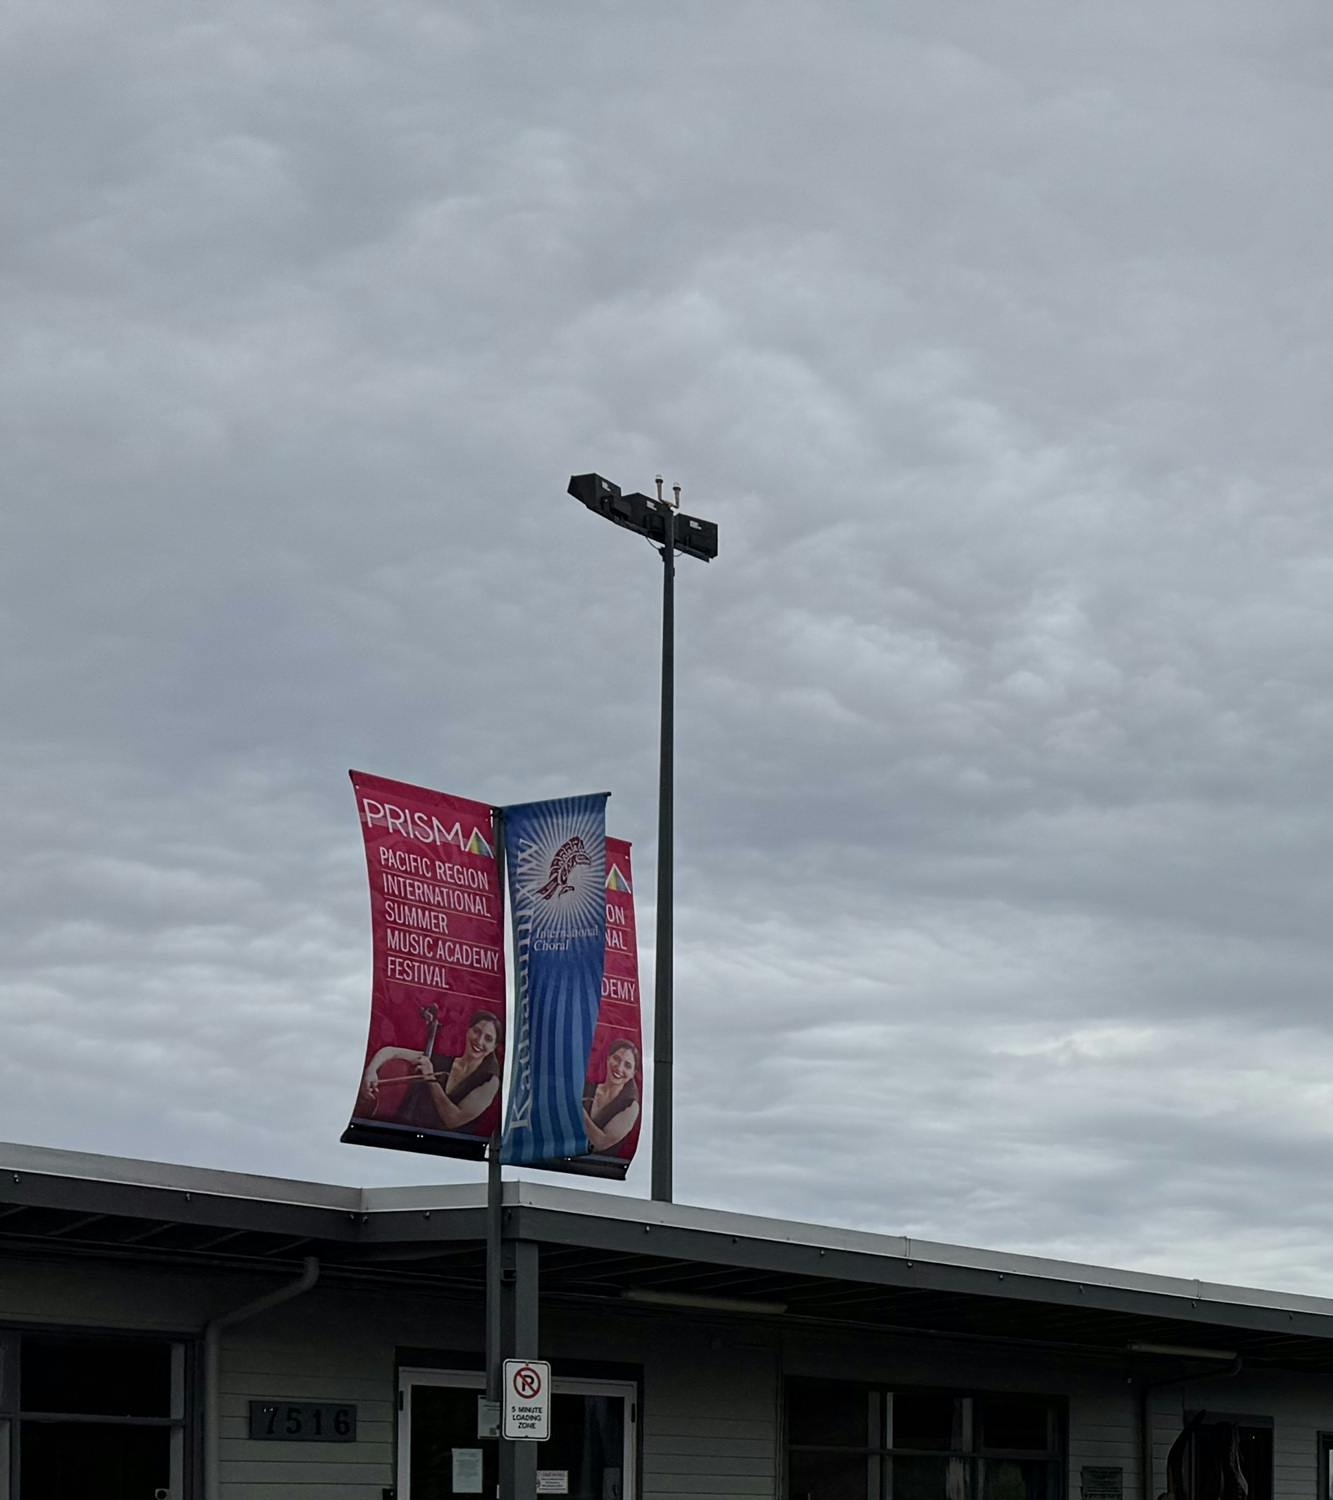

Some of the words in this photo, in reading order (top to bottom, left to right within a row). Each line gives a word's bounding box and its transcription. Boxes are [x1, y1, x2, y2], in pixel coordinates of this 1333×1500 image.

[379, 846, 432, 877] PACIFIC
[435, 861, 489, 890] REGION
[382, 873, 492, 917] INTERNATIONAL
[385, 902, 449, 934] SUMMER
[387, 928, 433, 957] MUSIC
[436, 940, 499, 972] ACADEMY
[533, 939, 569, 951] Choral
[387, 956, 450, 989] FESTIVAL
[601, 977, 637, 1002] DEMY
[263, 1407, 350, 1436] 7516
[512, 1414, 542, 1422] LOADING
[518, 1406, 543, 1414] MINUTE
